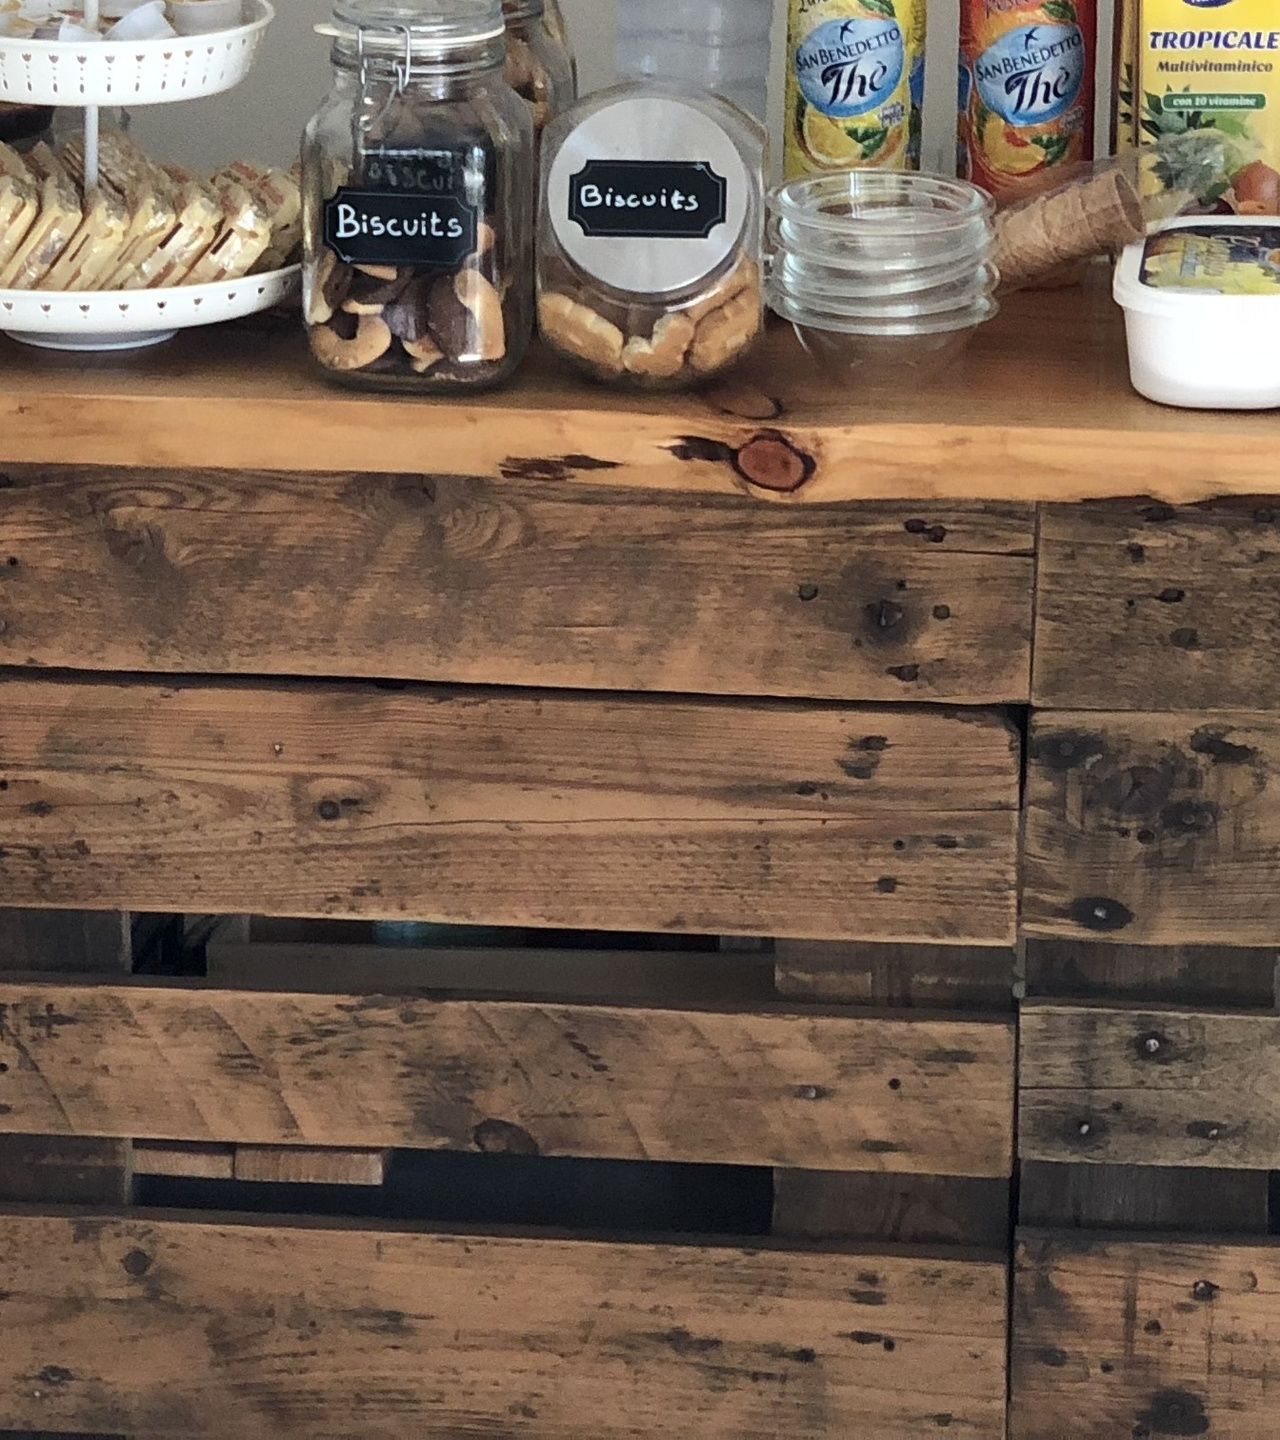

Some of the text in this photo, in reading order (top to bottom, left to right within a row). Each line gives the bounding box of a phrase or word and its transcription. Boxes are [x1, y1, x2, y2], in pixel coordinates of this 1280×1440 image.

[1150, 31, 1280, 49] TROPICALE
[1156, 60, 1273, 72] Multivitaminico
[580, 184, 700, 213] Biscuits
[336, 204, 463, 238] Biscuits
